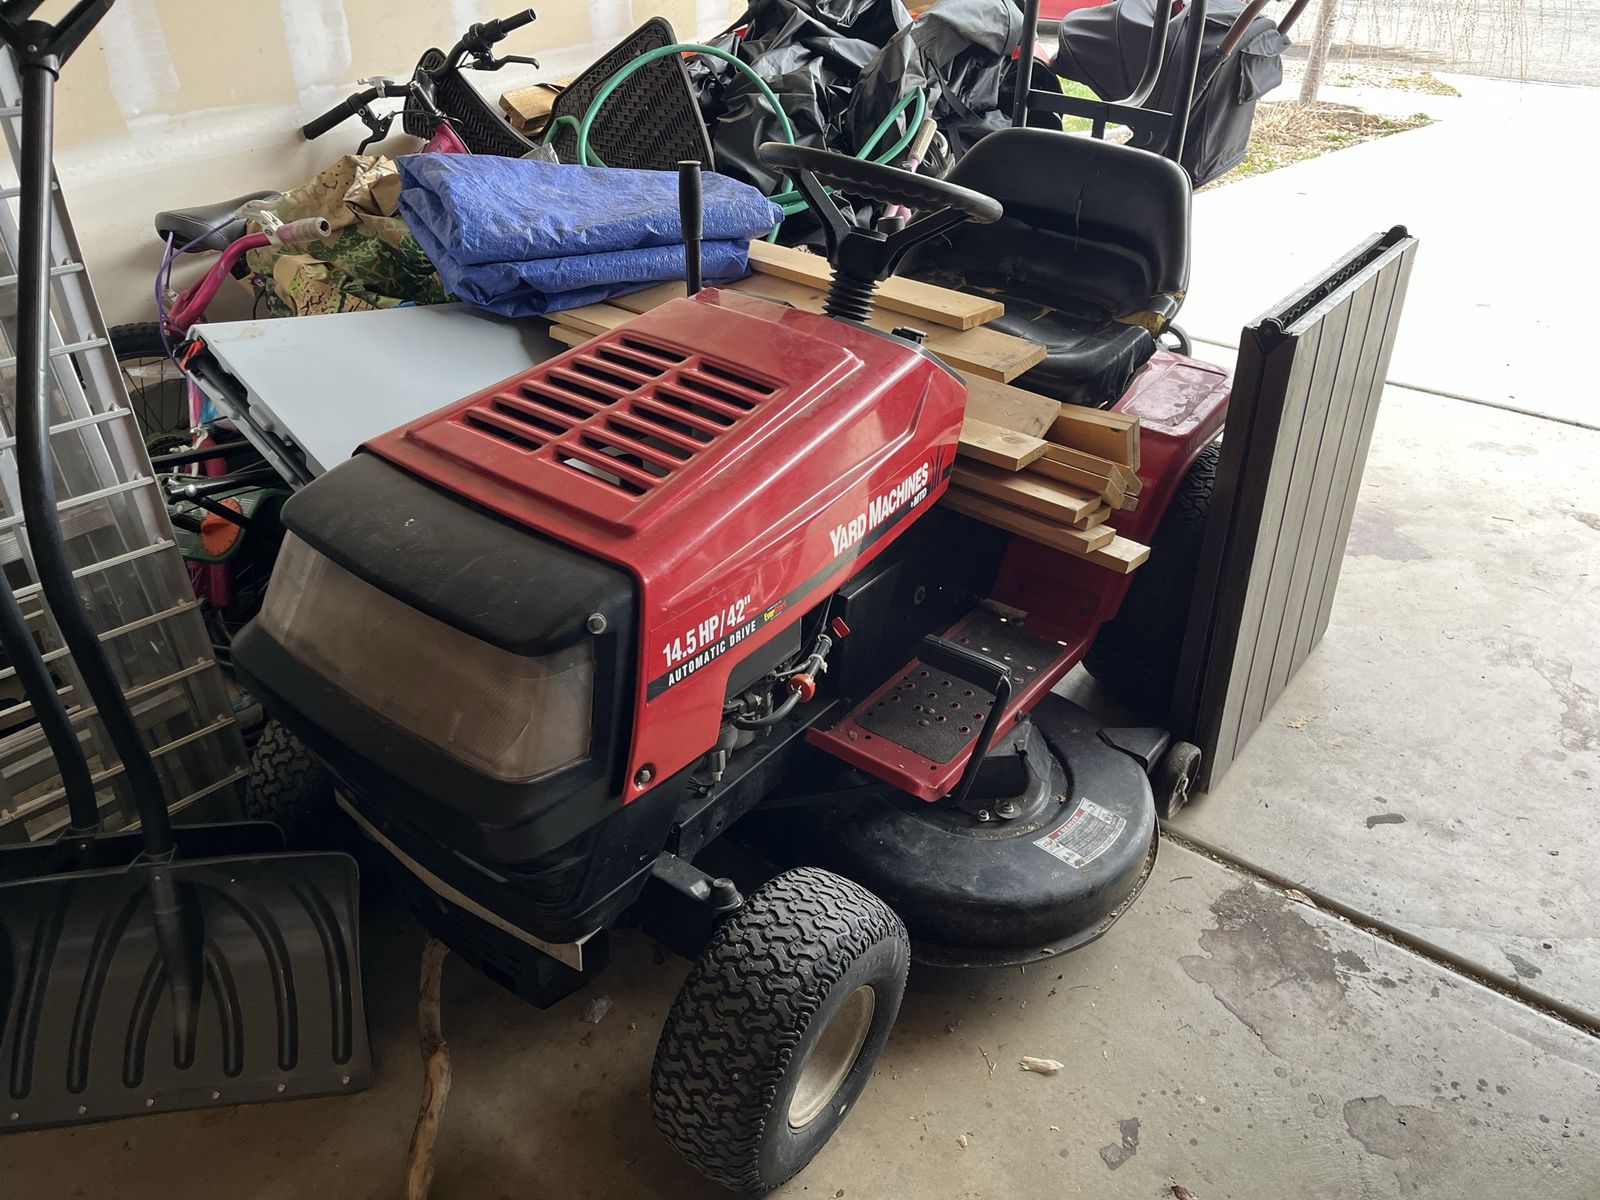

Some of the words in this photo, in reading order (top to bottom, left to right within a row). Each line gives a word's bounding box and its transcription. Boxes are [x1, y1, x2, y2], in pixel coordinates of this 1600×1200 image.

[829, 513, 866, 558] YARD
[868, 462, 929, 531] MACHINES
[662, 628, 697, 667] 14.5
[668, 640, 726, 687] AUTOMATIC
[729, 620, 756, 648] DRIVE
